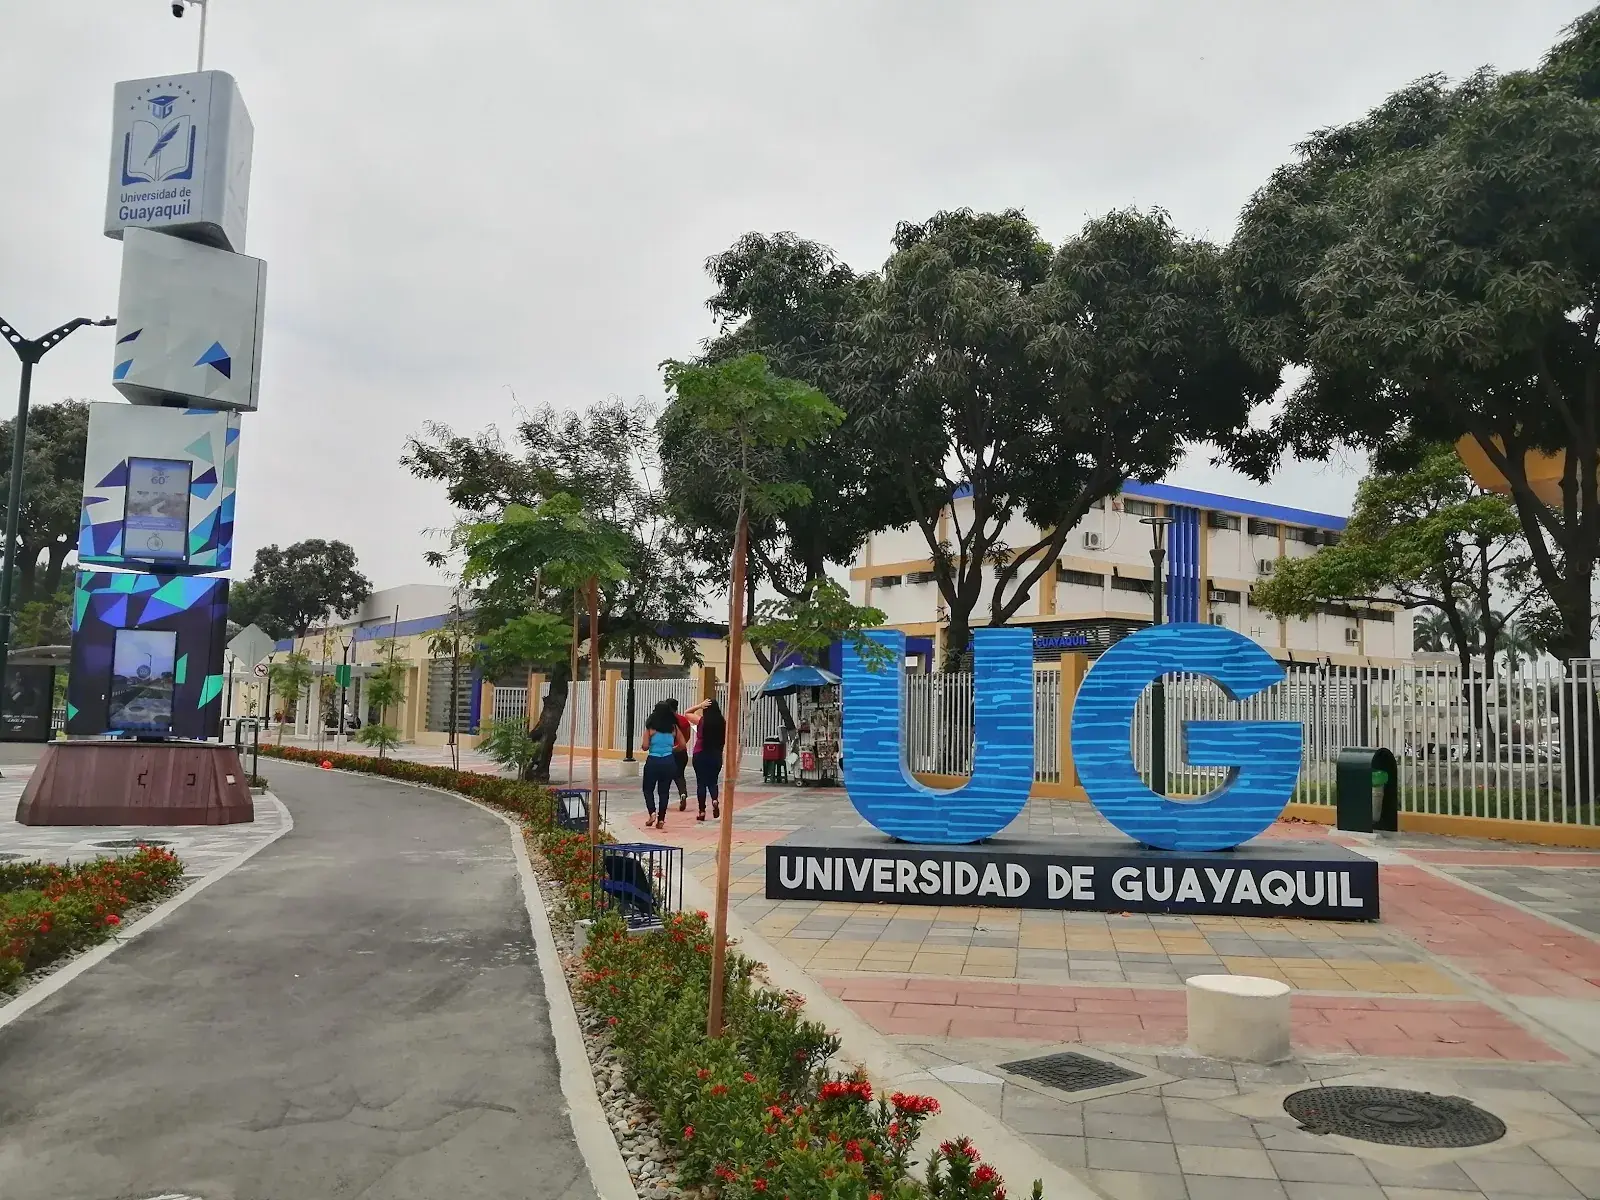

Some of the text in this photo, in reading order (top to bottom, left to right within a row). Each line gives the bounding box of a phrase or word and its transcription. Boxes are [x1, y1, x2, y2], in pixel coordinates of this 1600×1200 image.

[120, 186, 192, 203] Universidad de
[119, 199, 191, 222] Guayaquil
[1035, 636, 1088, 648] GUAYAQUIL
[841, 621, 1303, 852] UG
[779, 855, 1364, 909] UNIVERSIDAD DE GUAYAQUIL
